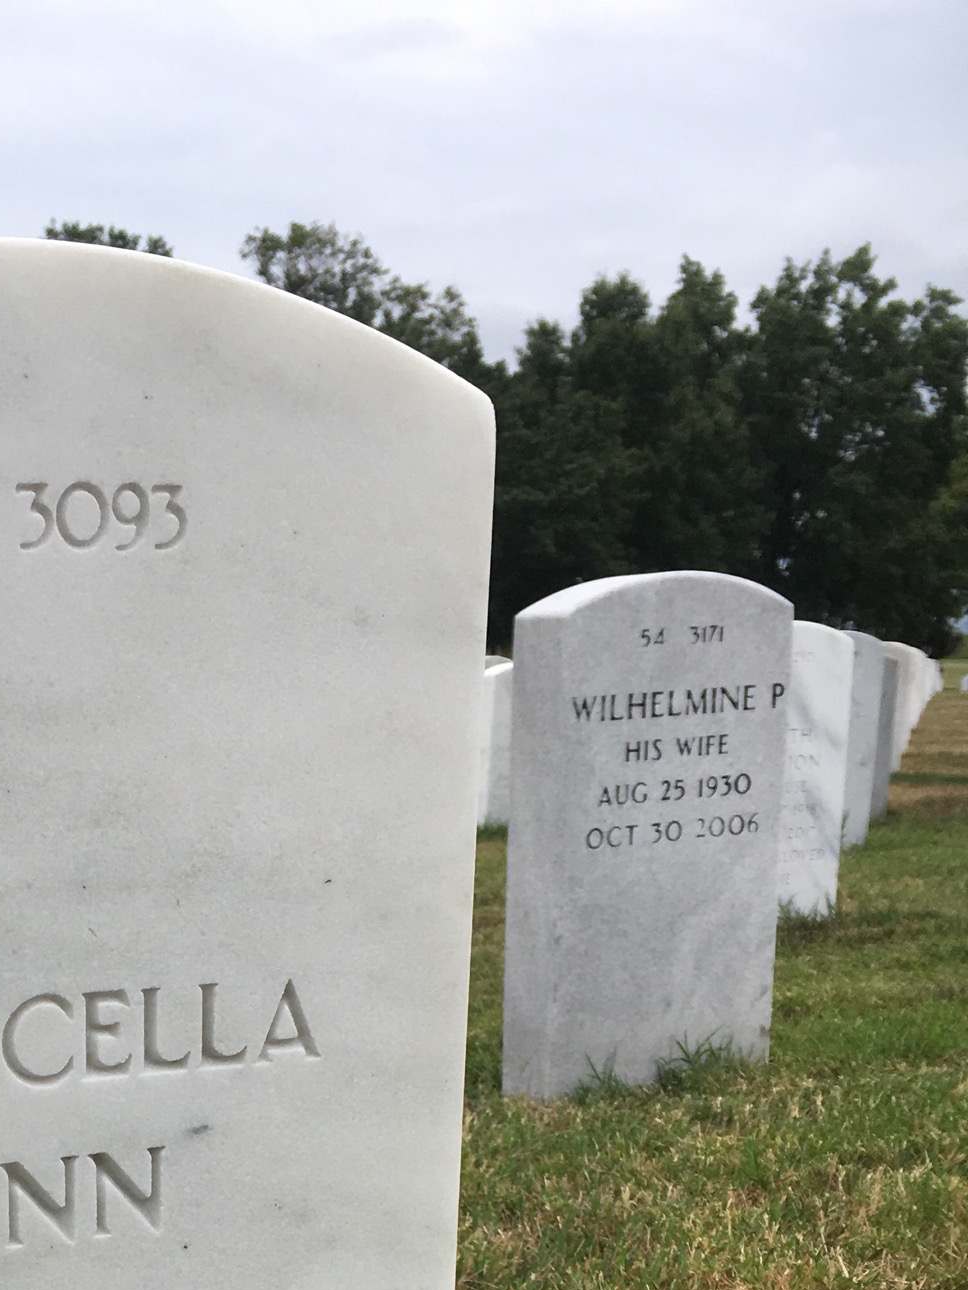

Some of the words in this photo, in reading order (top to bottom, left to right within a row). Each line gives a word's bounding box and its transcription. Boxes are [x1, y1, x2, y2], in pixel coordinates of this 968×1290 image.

[15, 480, 189, 551] 3093
[640, 628, 665, 647] 54
[690, 625, 726, 645] 3171
[572, 683, 757, 722] WILHELMINE
[771, 682, 785, 709] P
[625, 738, 662, 763] HIS
[676, 733, 730, 757] WIFE
[597, 783, 648, 808] AUG
[661, 778, 687, 802] 25
[698, 772, 753, 798] 1930
[585, 825, 639, 850] OCT
[651, 818, 683, 843] 30
[696, 811, 760, 839] 2006
